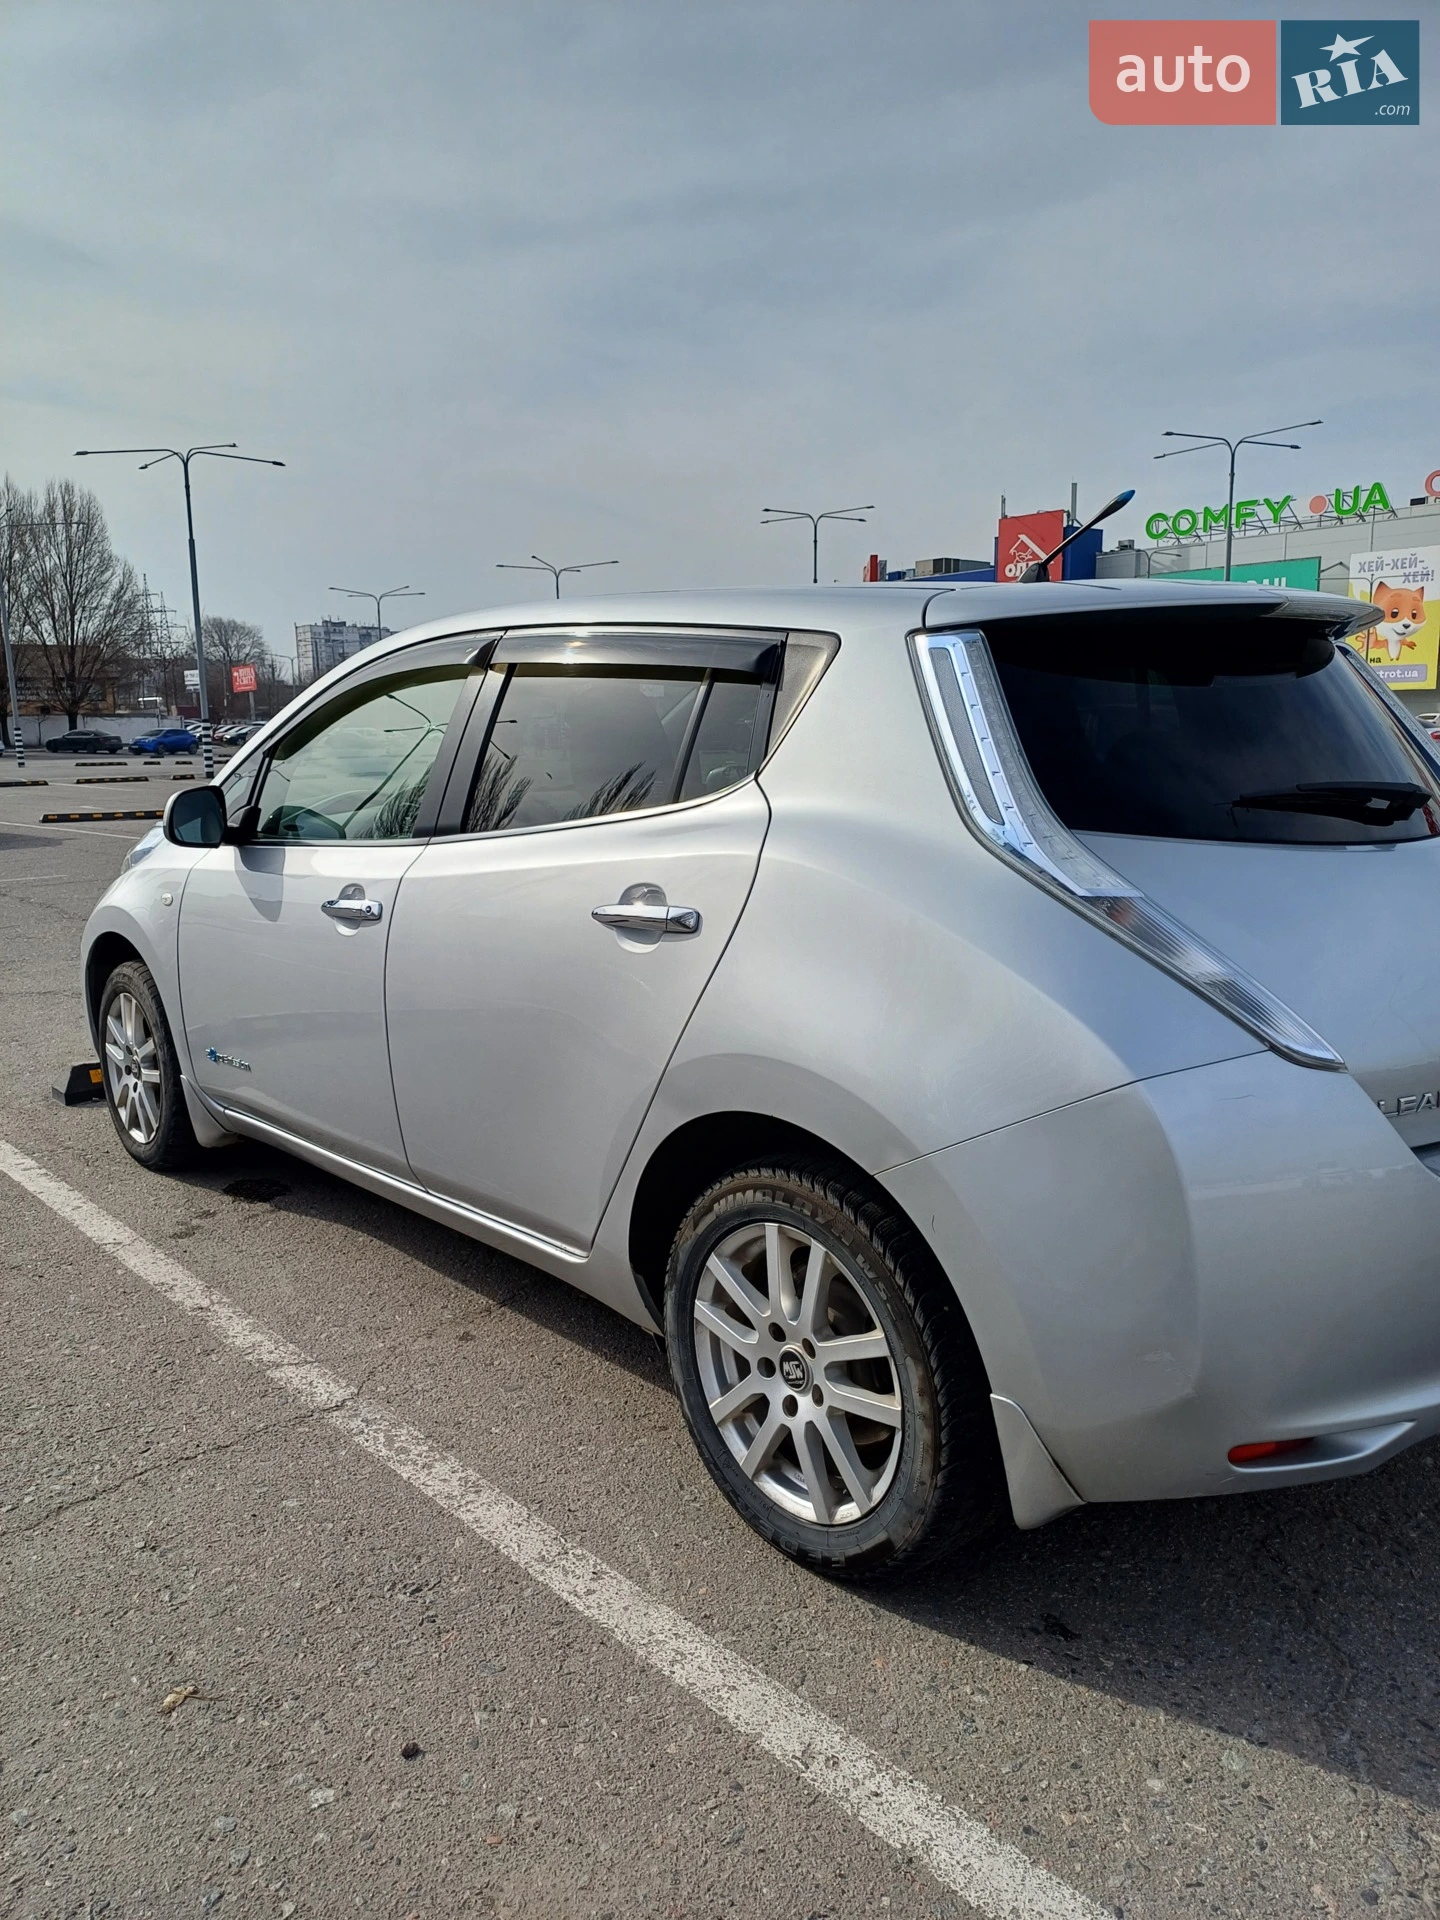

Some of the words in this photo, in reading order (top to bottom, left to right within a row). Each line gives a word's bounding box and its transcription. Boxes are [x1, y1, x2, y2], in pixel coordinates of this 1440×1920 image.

[1145, 494, 1292, 541] COMFY
[1358, 552, 1425, 574] ХЕЙ-ХЕЙ-
[1402, 566, 1435, 584] ХЕЙ!
[1377, 668, 1419, 679] trot.ua
[1378, 1090, 1440, 1117] LEA
[713, 1188, 856, 1247] HIMALAYA
[783, 1360, 803, 1379] MSW
